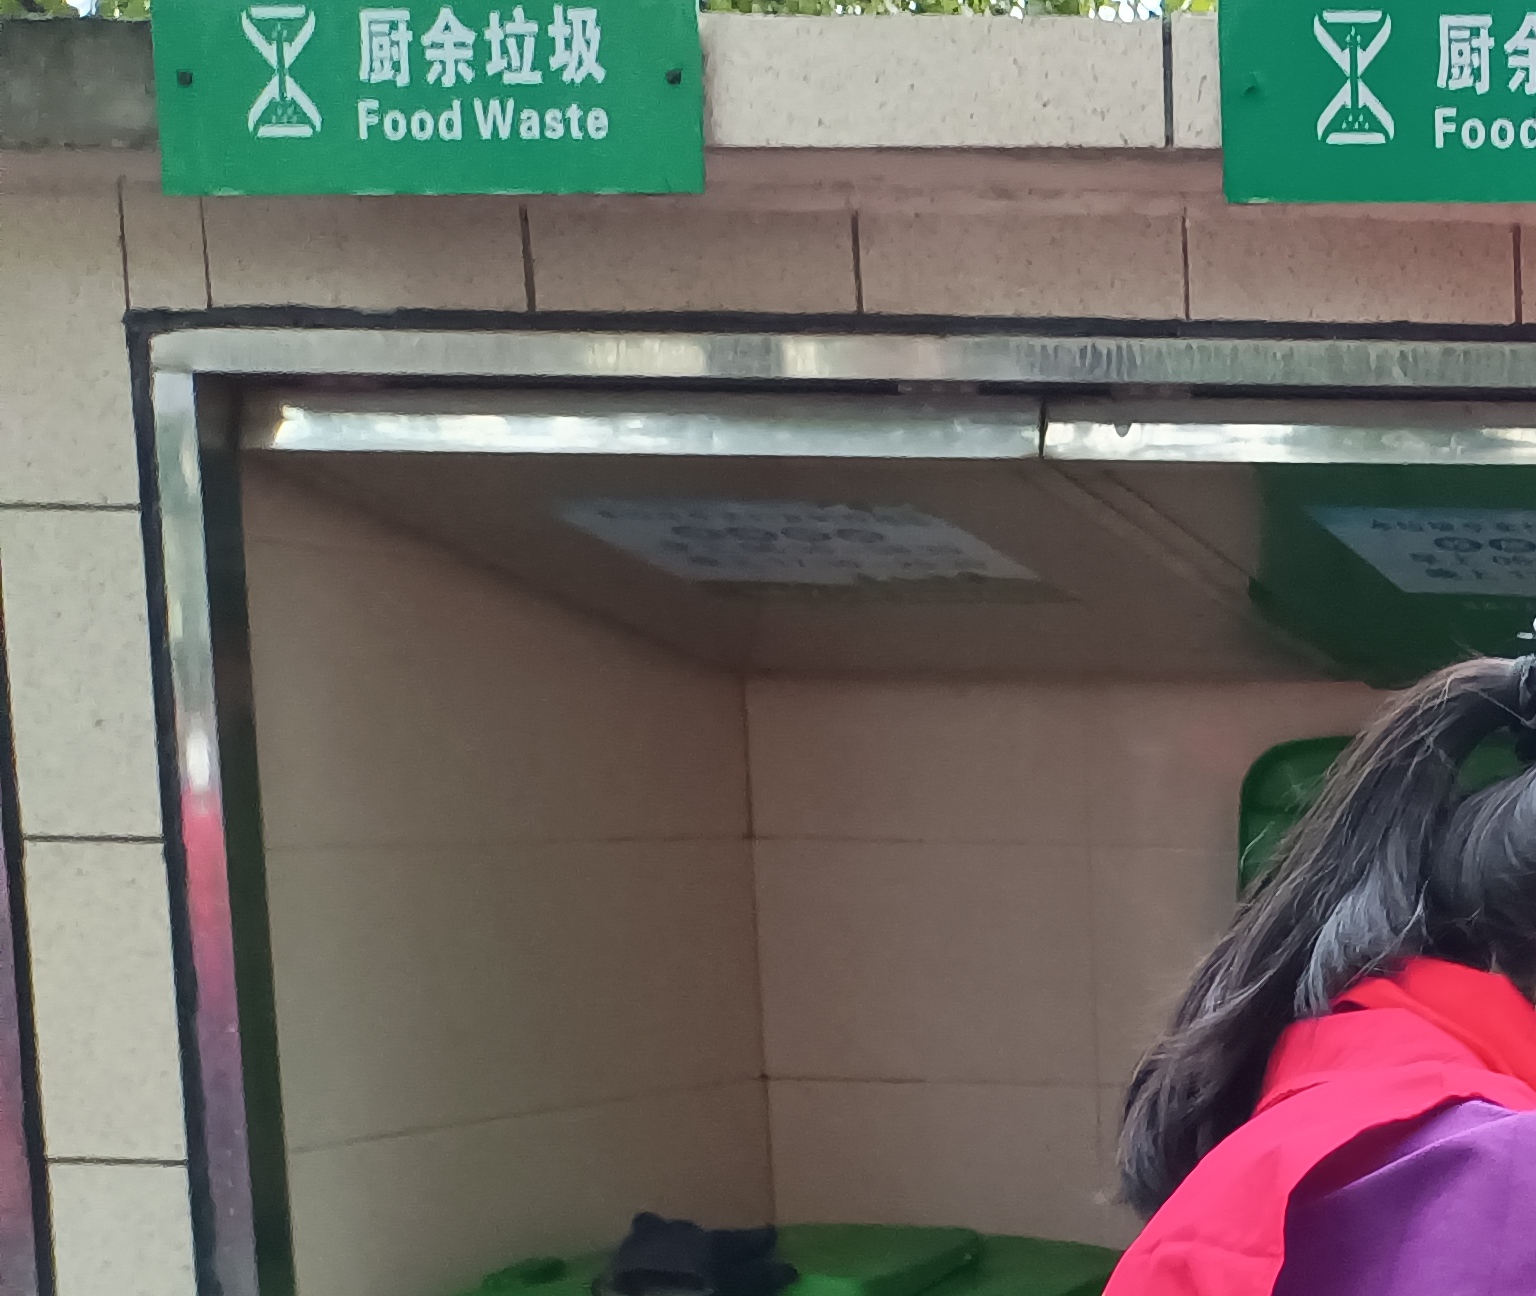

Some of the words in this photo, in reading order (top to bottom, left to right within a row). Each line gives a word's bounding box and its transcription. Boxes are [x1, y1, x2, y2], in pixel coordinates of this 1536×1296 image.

[358, 4, 607, 88] 厨余垃圾
[357, 98, 463, 142] Food
[472, 99, 610, 141] Waste
